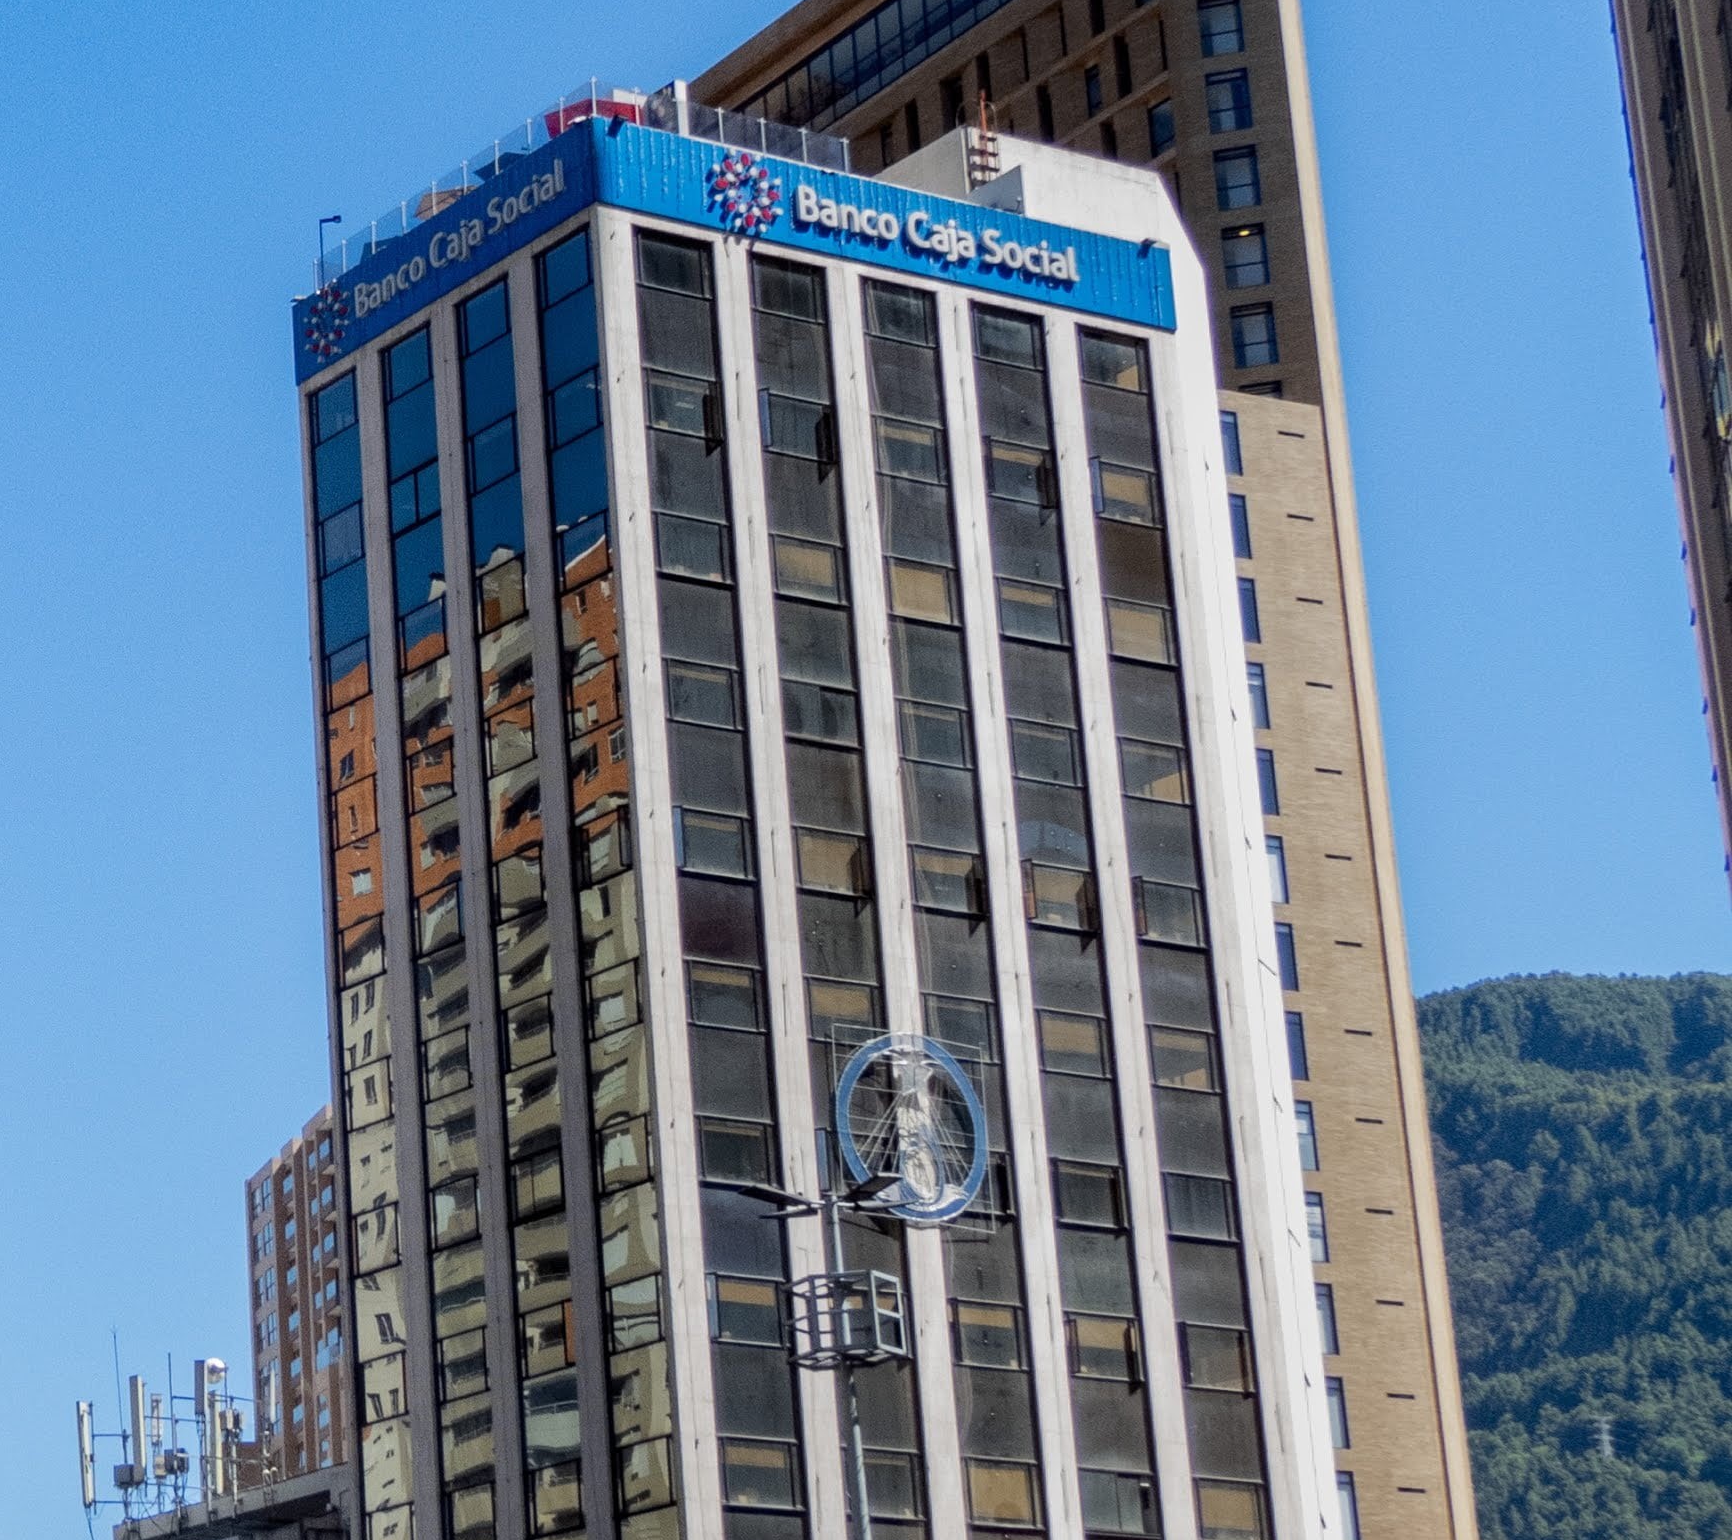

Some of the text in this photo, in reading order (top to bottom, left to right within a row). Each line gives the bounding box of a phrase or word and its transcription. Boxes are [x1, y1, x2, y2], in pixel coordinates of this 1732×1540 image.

[354, 158, 565, 318] Banco Caja Social
[796, 184, 1081, 283] Banco Caja Social
